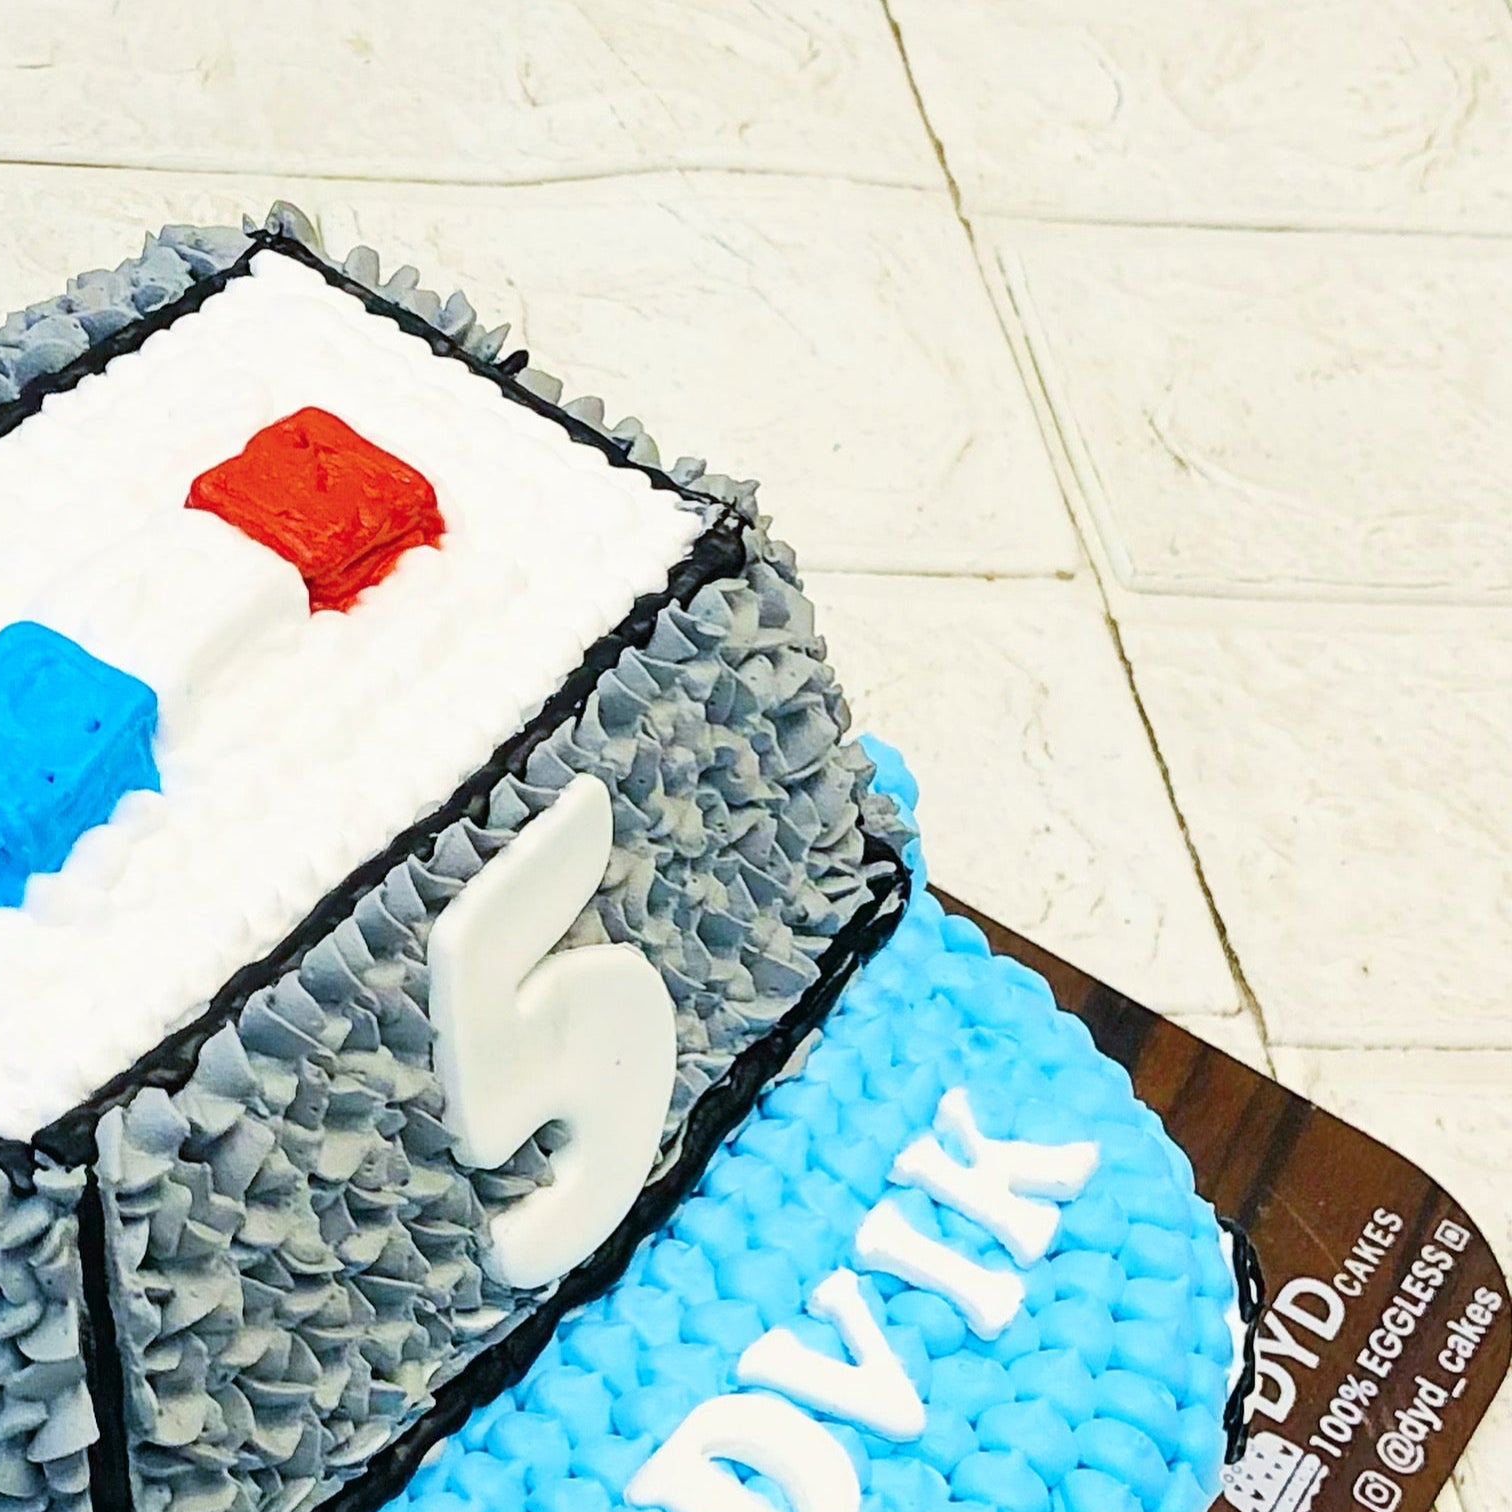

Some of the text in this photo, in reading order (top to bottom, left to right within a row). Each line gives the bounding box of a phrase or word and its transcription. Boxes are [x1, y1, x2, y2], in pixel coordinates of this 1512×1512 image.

[426, 773, 677, 1291] 5
[1254, 1207, 1403, 1424] DYD CAKES
[1310, 1245, 1455, 1457] 100% EGGLESS
